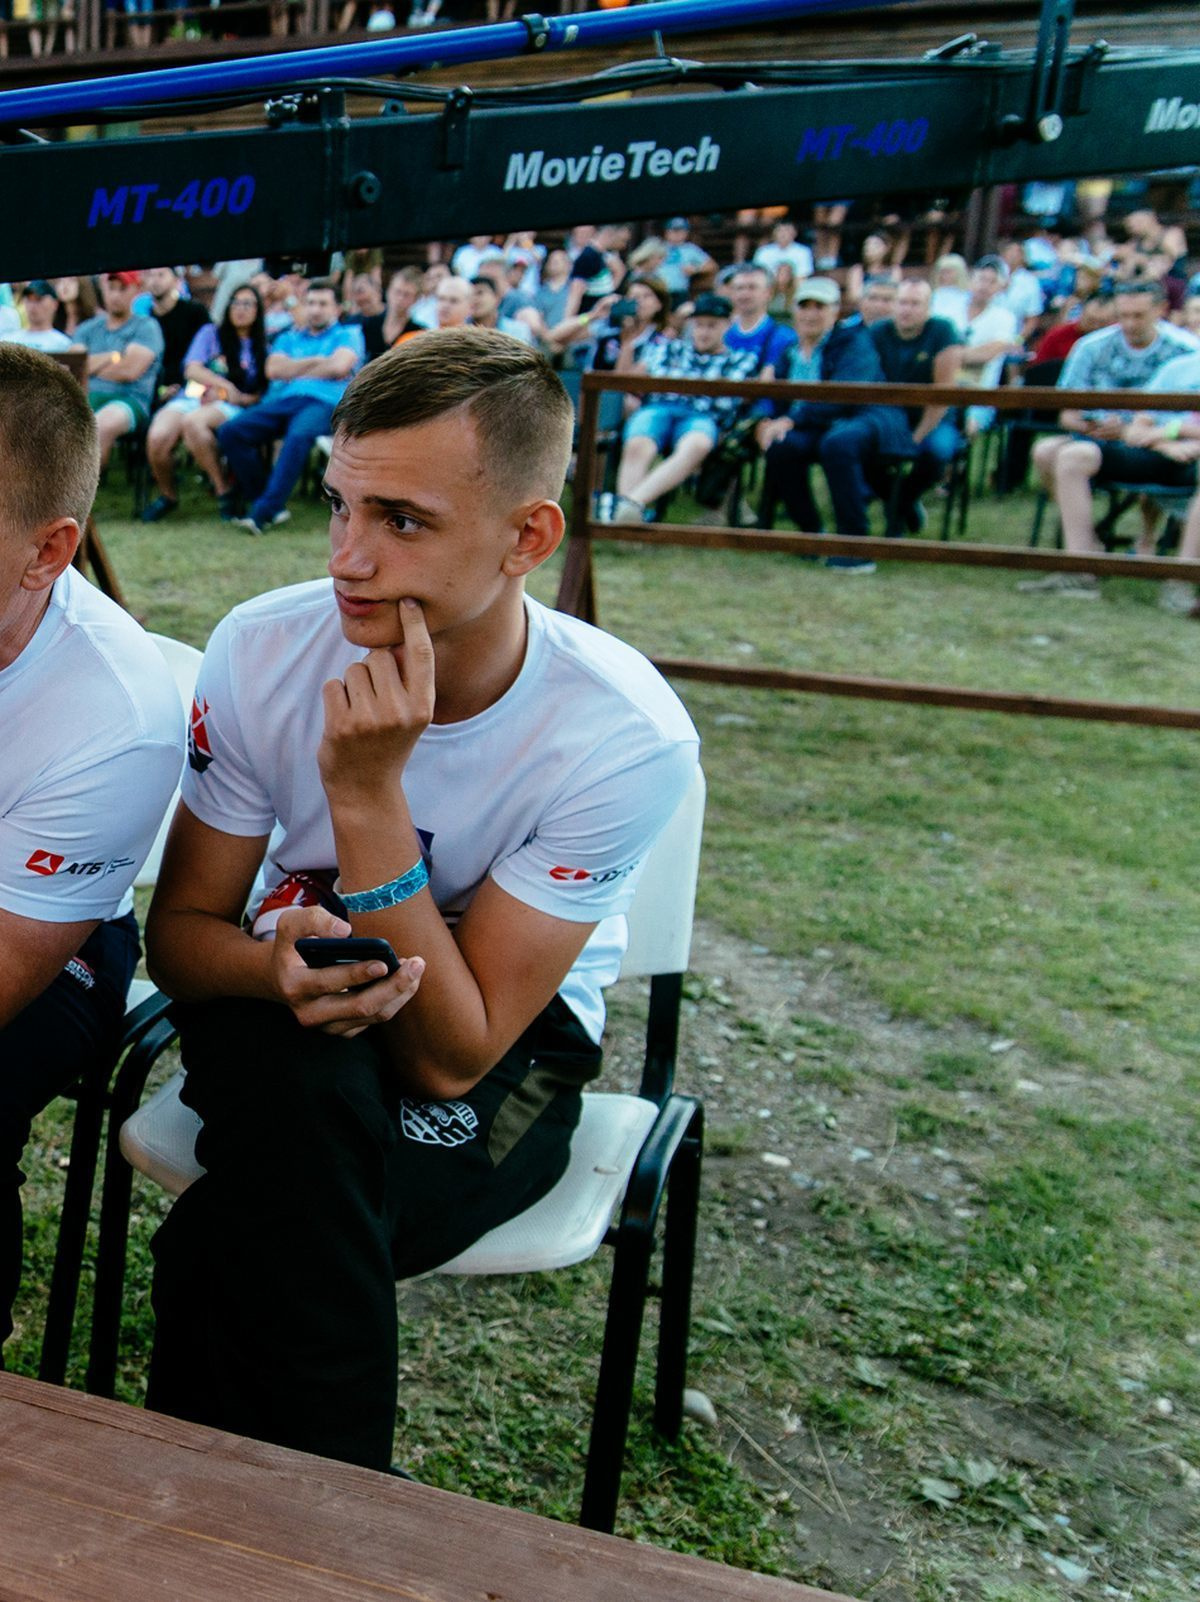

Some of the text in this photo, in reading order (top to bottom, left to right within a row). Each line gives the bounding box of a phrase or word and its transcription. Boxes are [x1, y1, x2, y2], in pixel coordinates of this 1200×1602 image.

[1144, 95, 1200, 134] Mo
[503, 136, 721, 191] MovieTech
[797, 118, 930, 163] MT-400
[87, 174, 256, 229] MT-400
